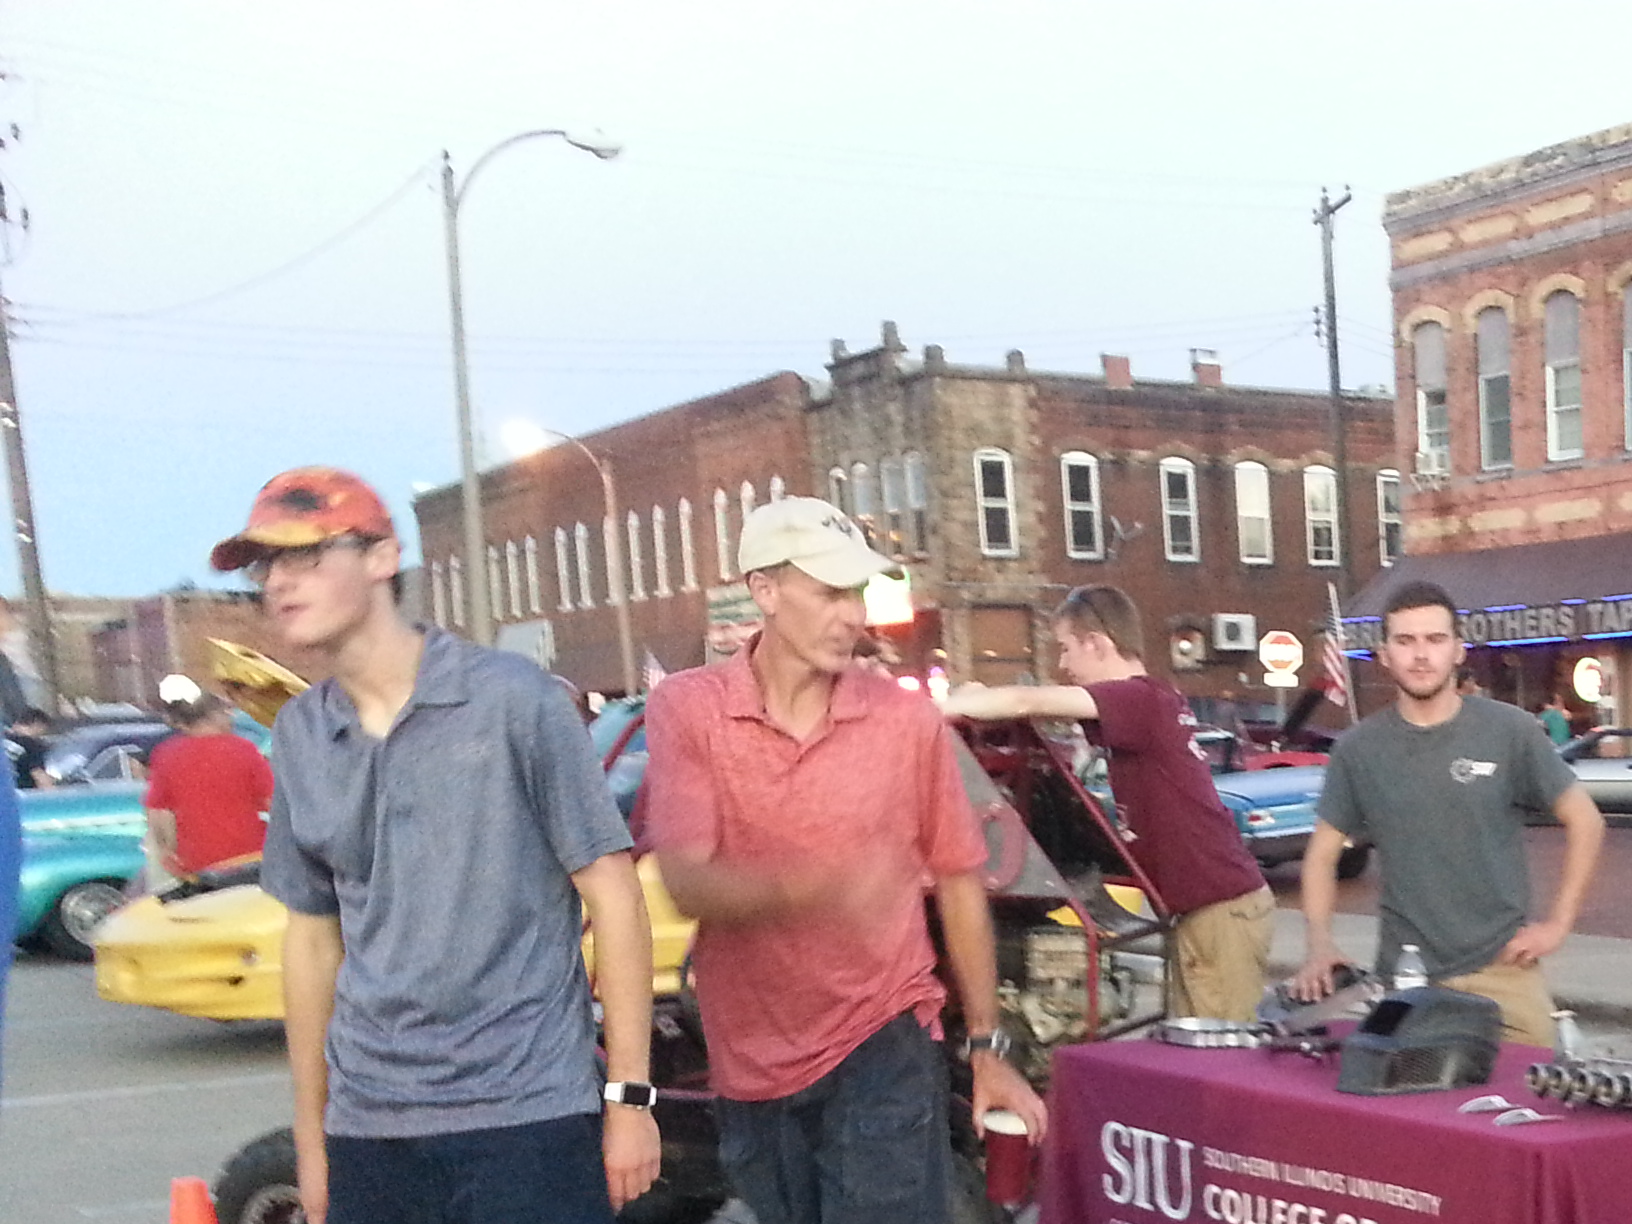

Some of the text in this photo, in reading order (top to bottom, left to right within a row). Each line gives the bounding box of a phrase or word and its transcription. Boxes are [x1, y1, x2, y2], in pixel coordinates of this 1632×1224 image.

[1457, 605, 1576, 642] ROTHERS
[1101, 1120, 1194, 1221] SIU
[1202, 1146, 1442, 1217] SOUTHERN ILLINOIS UNIVERSITY
